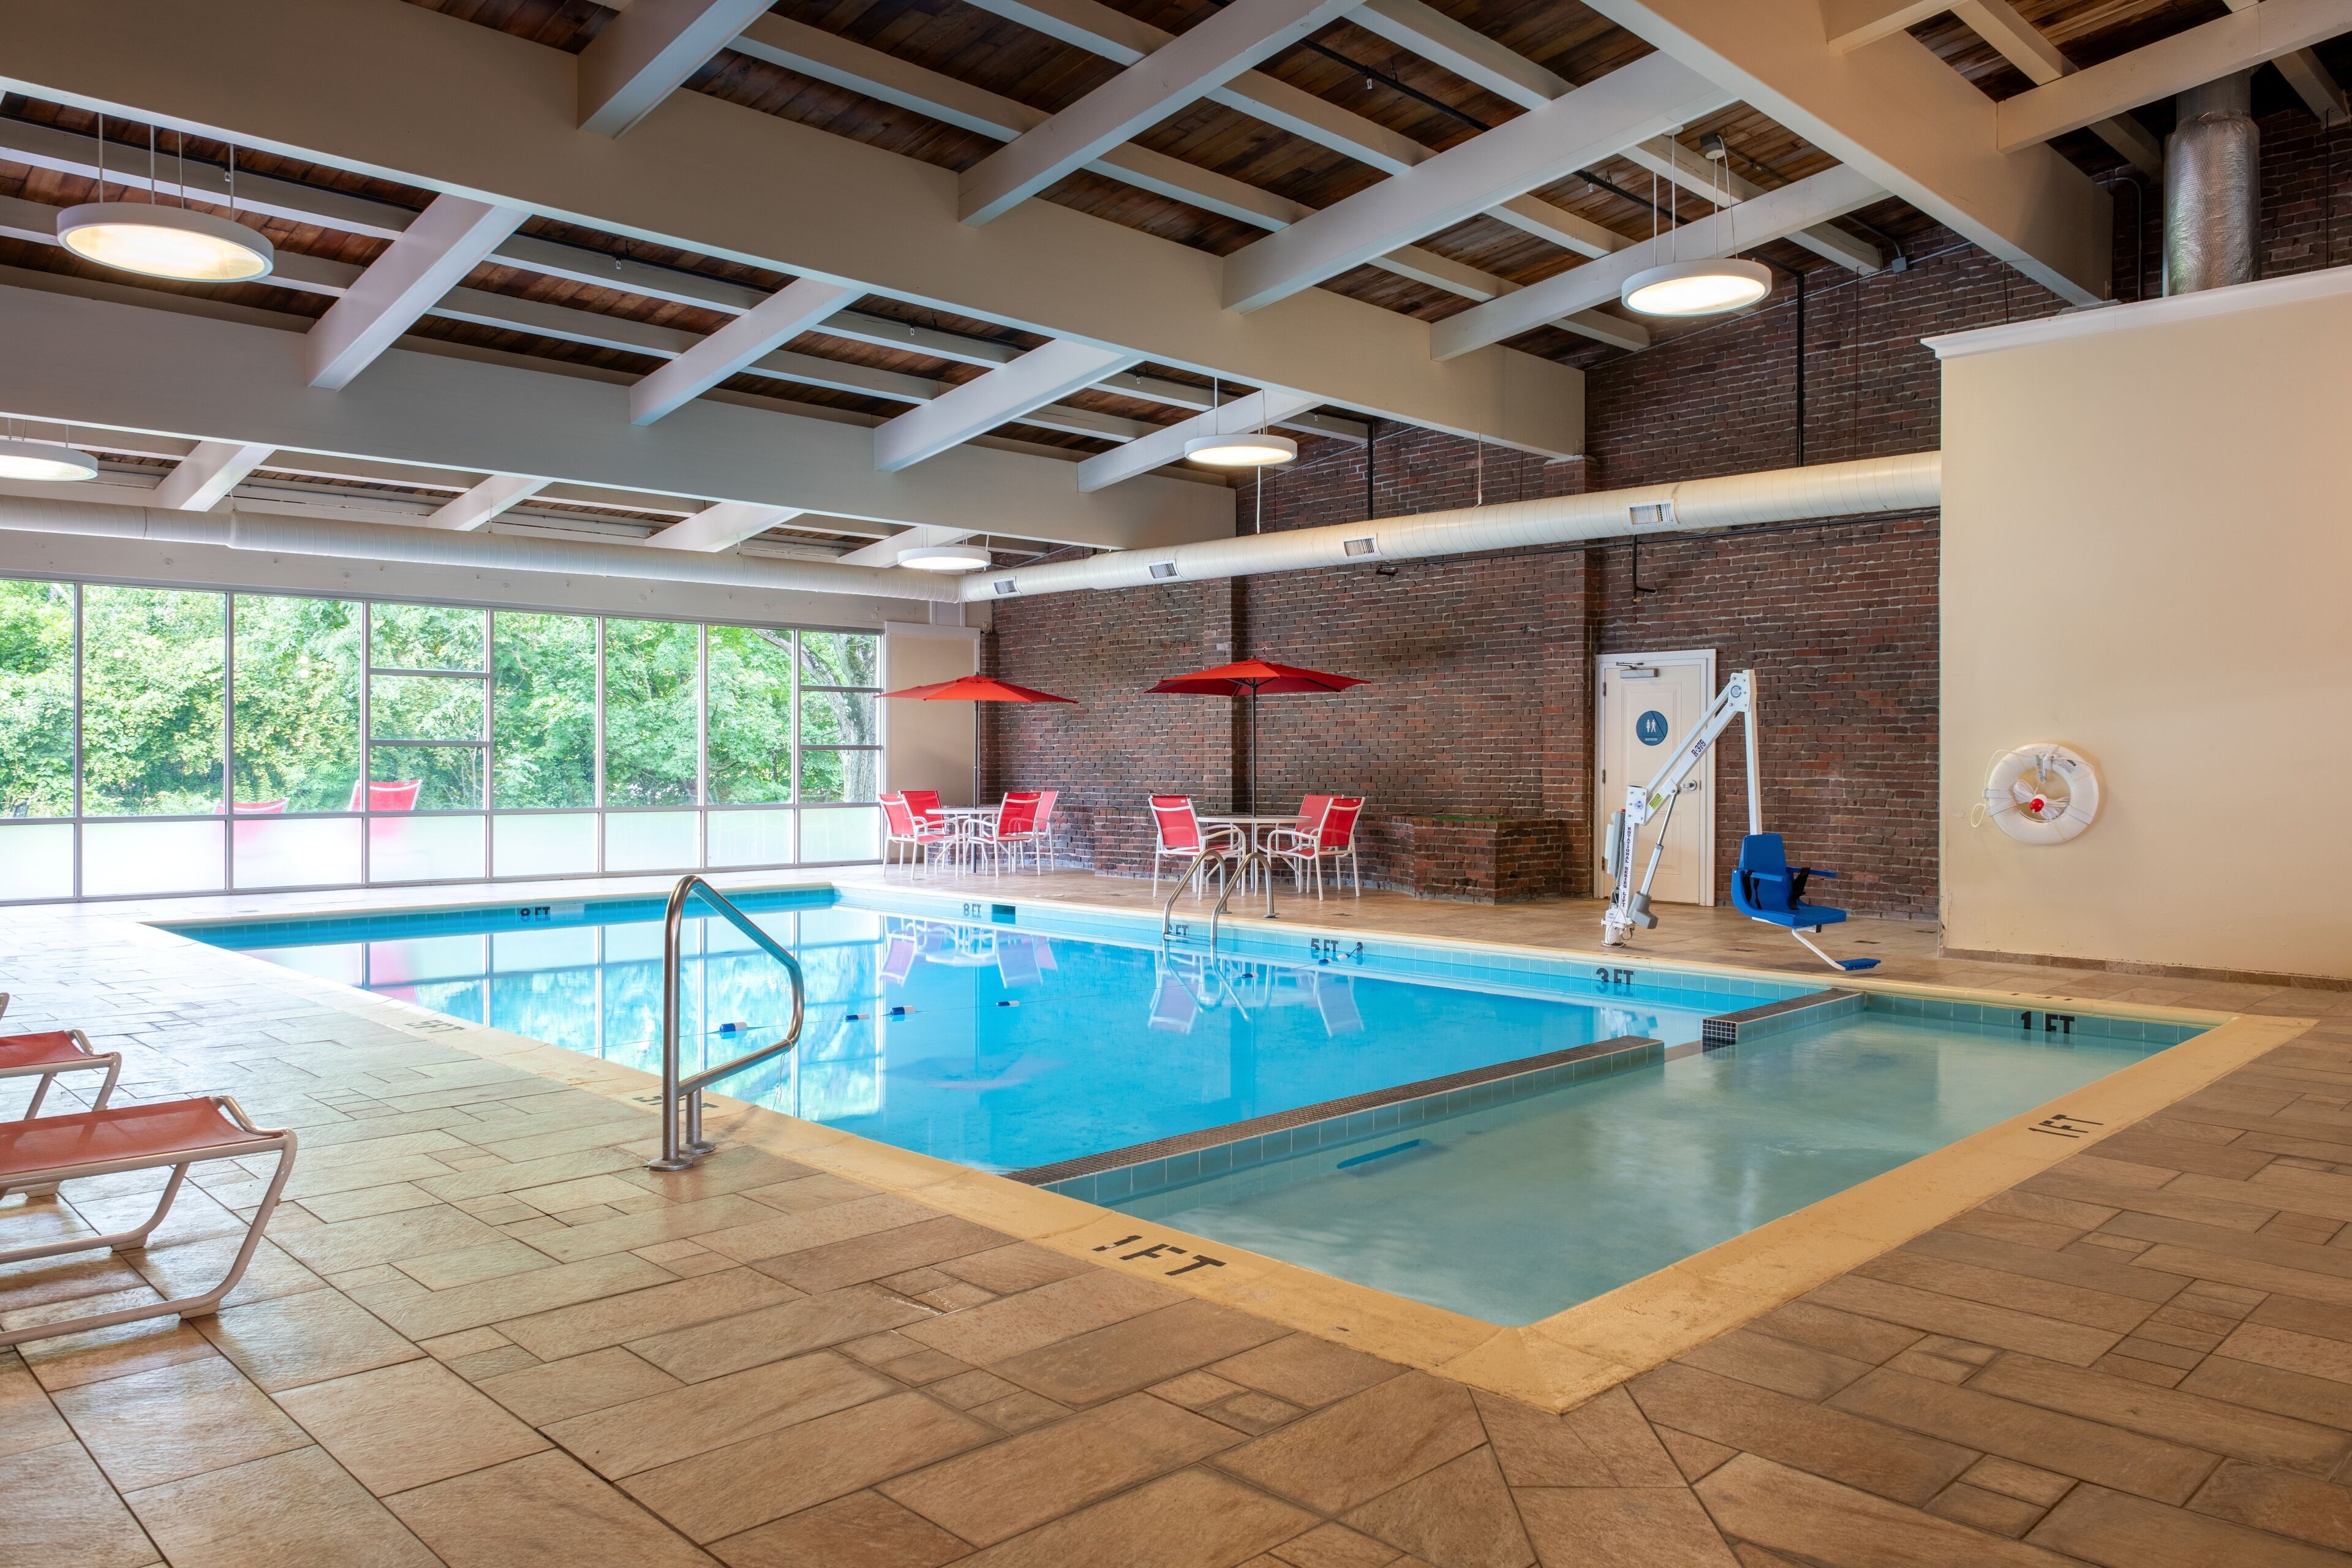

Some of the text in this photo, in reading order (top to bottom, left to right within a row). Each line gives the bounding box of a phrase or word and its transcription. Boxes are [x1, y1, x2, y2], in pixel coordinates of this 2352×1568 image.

[1324, 940, 1338, 951] FT
[1596, 968, 1634, 984] 3 FT
[2021, 1011, 2075, 1034] 1 FT
